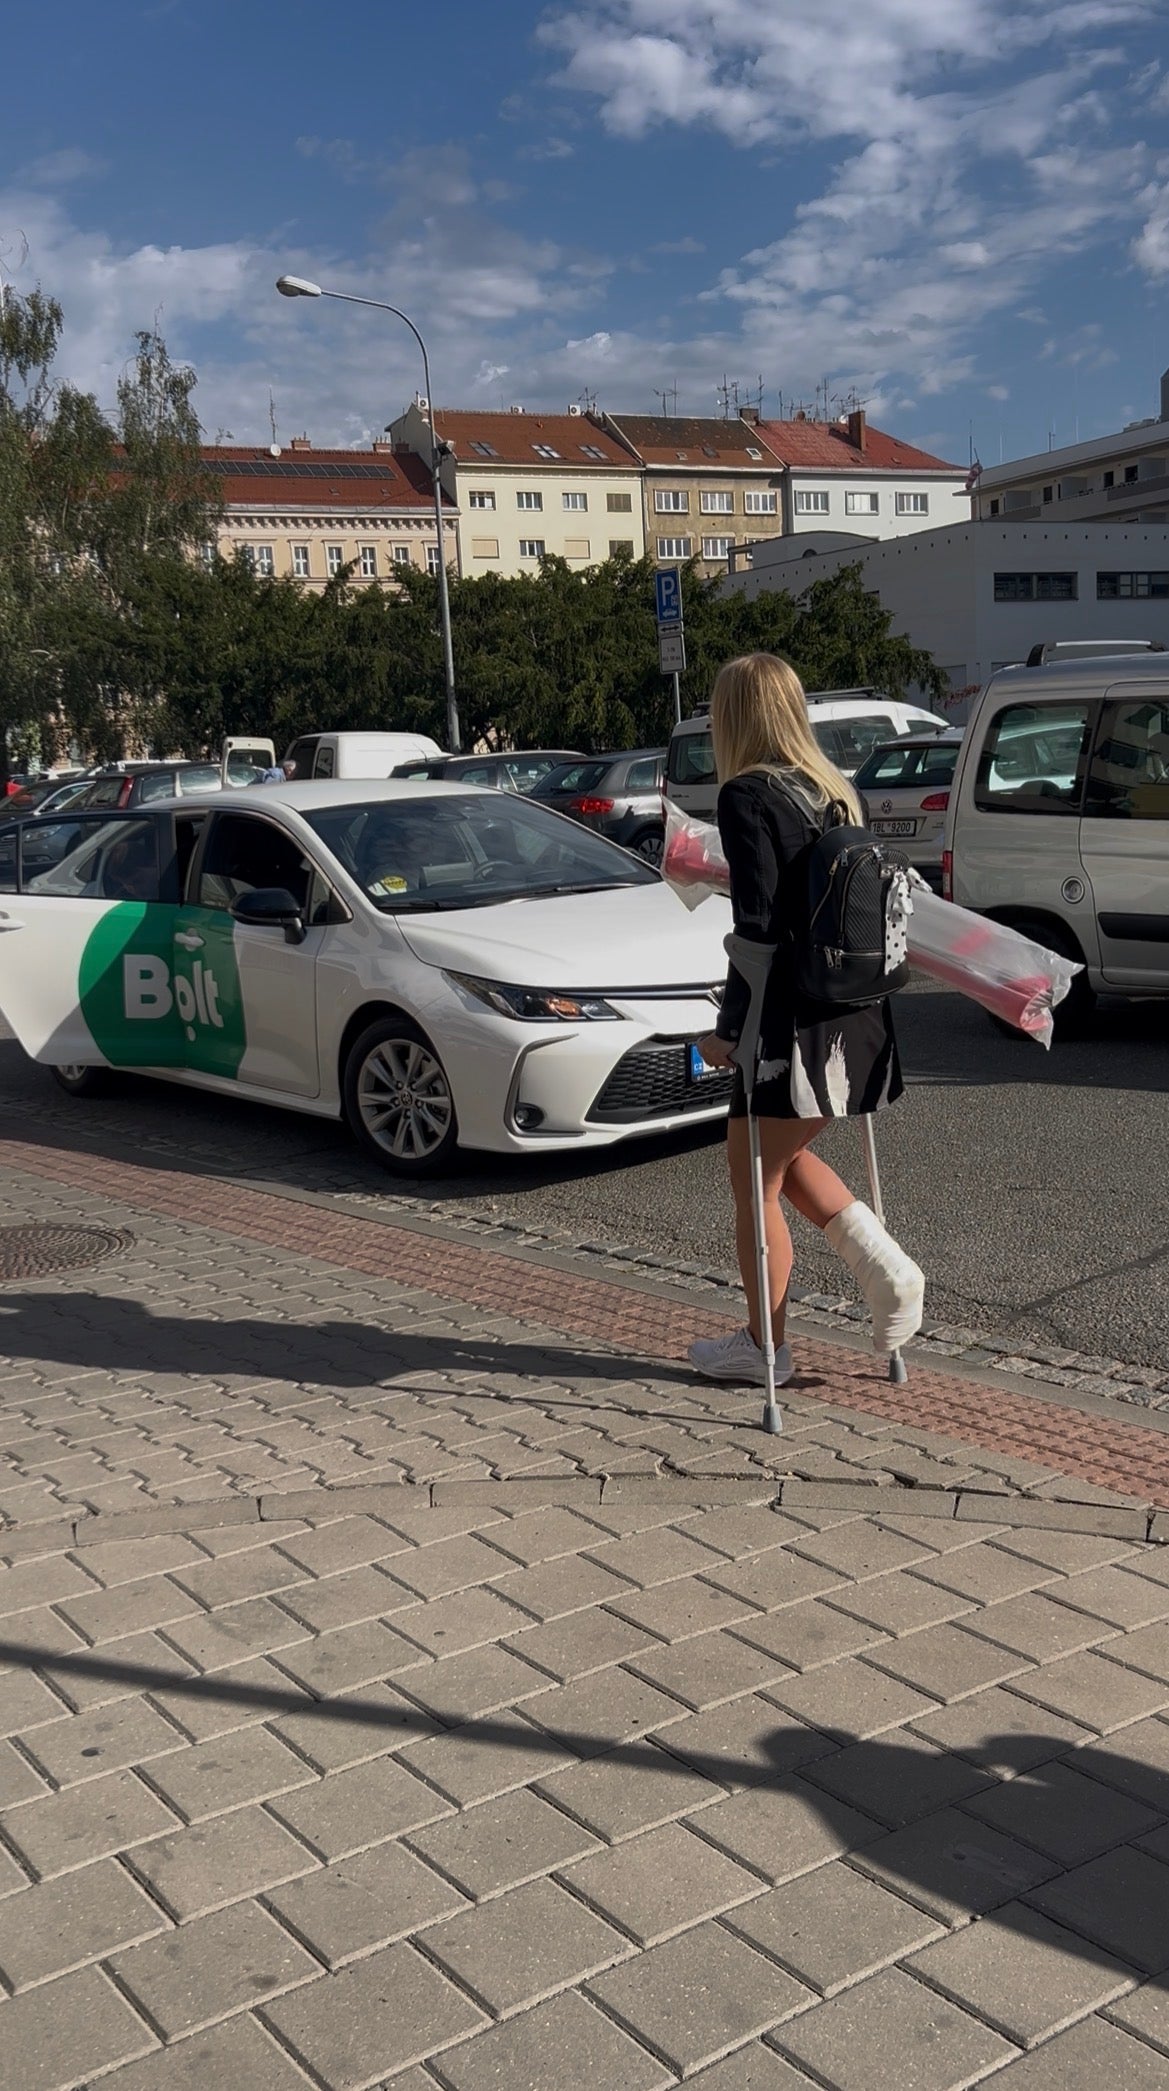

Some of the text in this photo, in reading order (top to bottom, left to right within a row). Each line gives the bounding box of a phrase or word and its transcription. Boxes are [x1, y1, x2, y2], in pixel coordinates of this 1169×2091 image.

[661, 576, 675, 606] P
[872, 822, 911, 833] 1BL 9200
[122, 953, 225, 1029] Bolt
